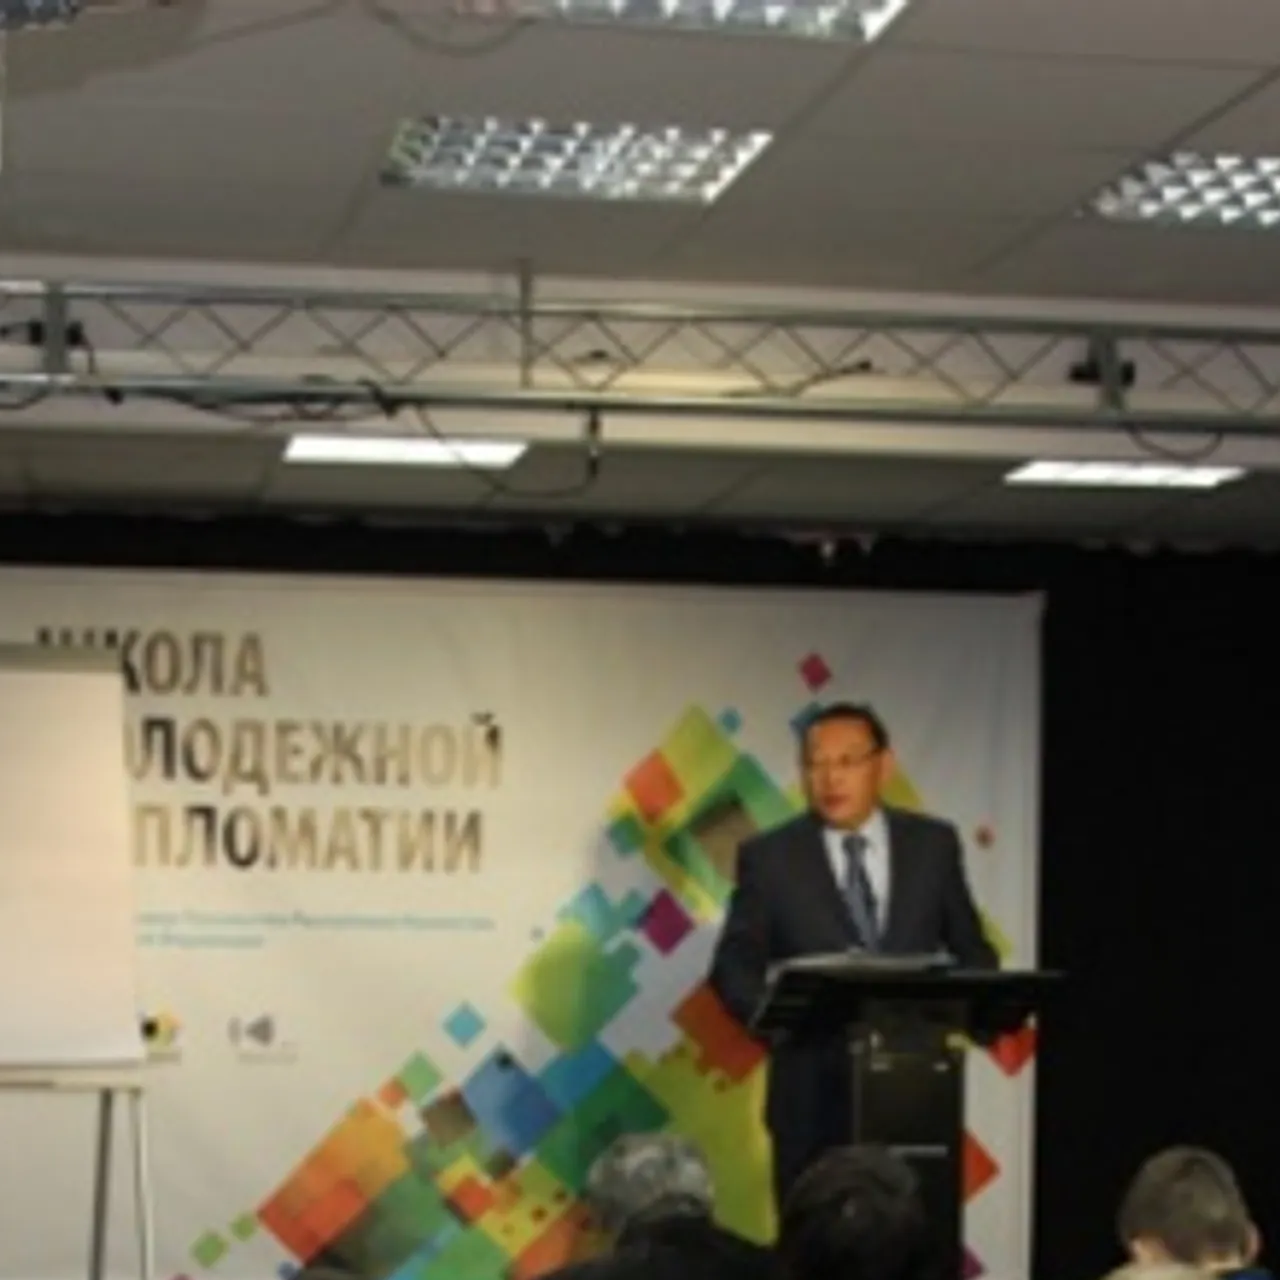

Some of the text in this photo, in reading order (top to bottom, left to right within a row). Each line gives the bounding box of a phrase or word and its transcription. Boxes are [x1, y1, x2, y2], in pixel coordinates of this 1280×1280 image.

[36, 626, 270, 697] КОЛА
[123, 713, 503, 796] ЛОДЕЖНОЙ
[132, 804, 485, 873] ПЛОМАТИИ
